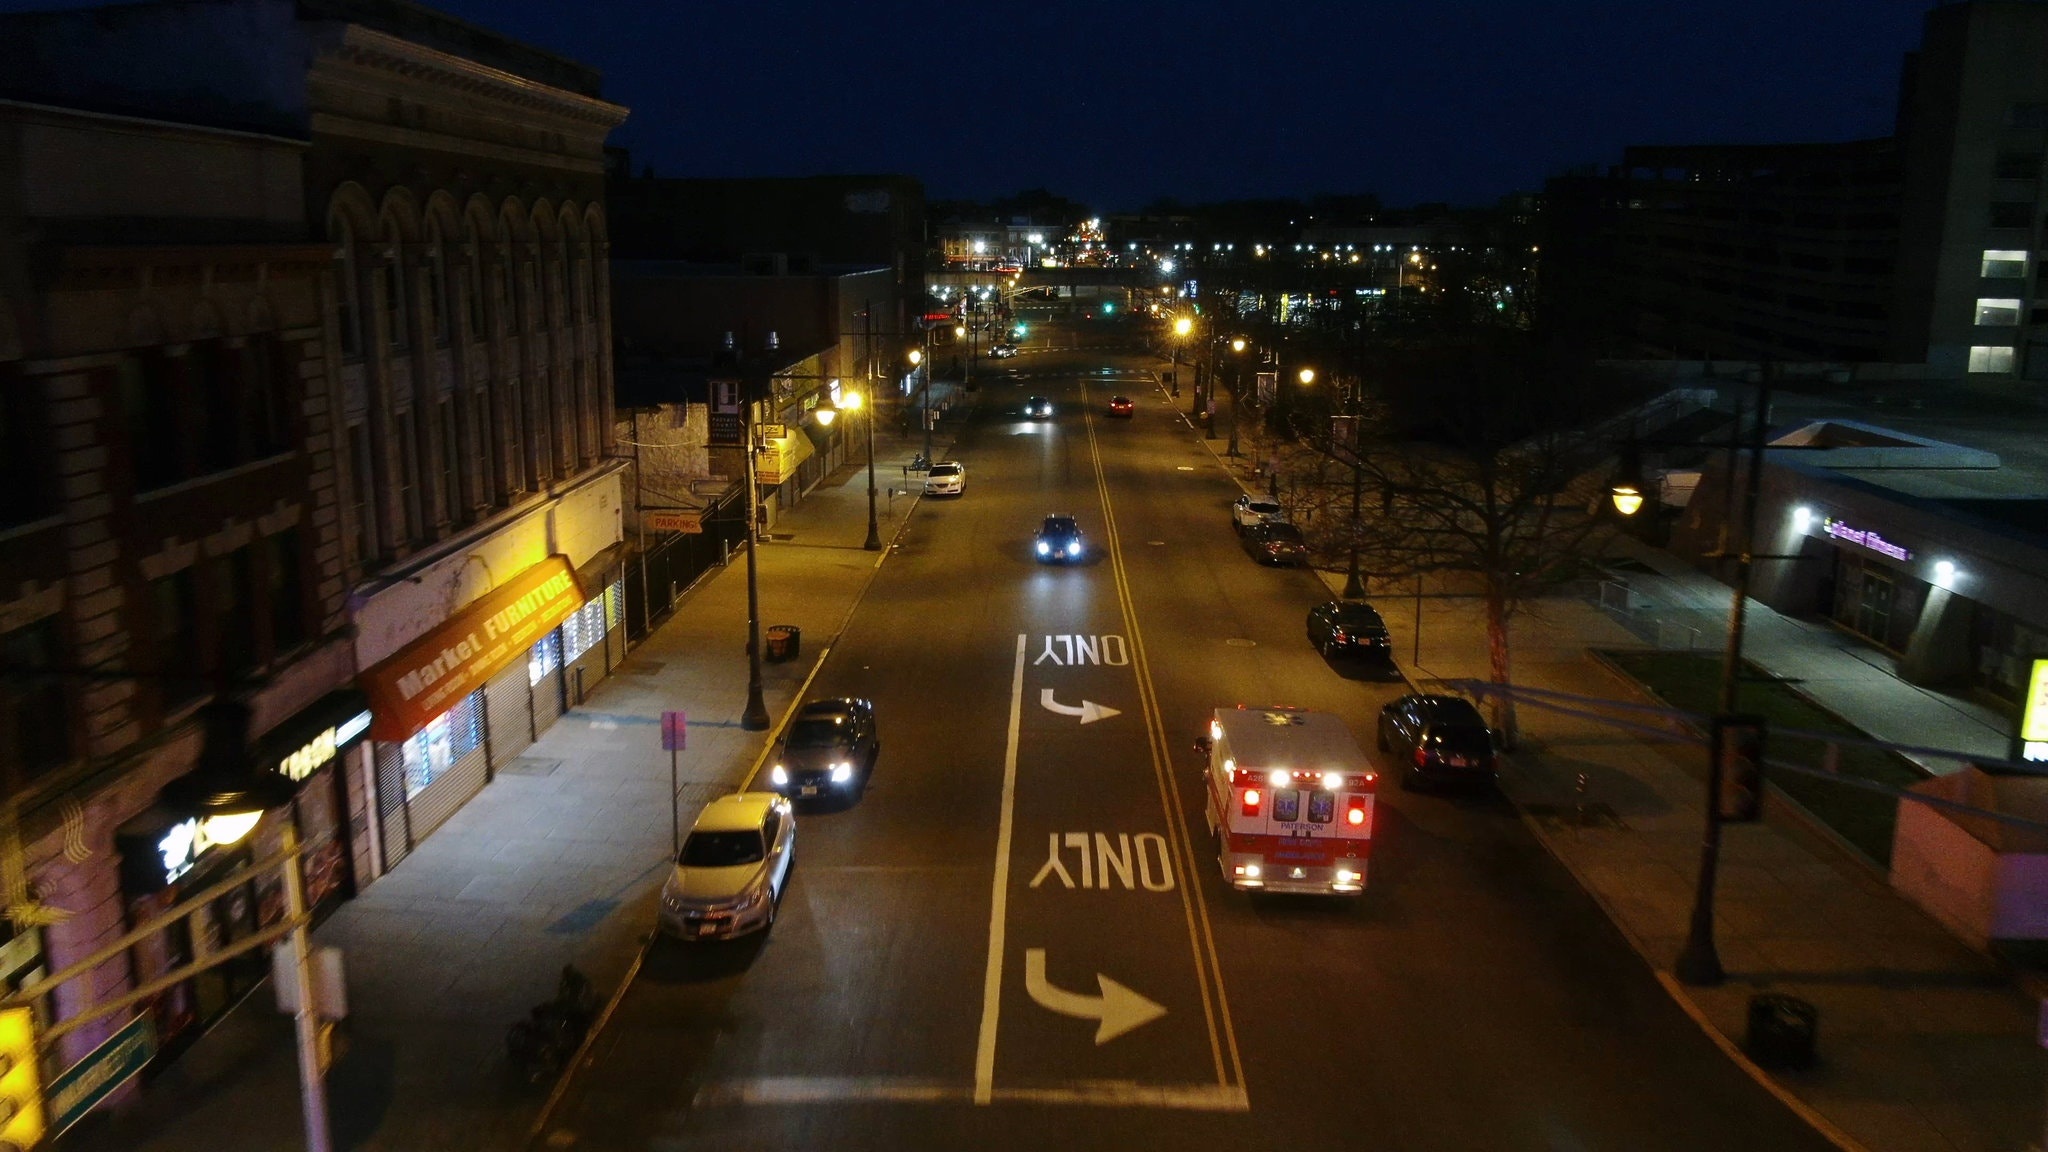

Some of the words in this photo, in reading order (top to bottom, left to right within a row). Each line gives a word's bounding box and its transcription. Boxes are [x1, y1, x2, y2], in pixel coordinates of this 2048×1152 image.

[656, 518, 697, 530] PARKING
[397, 633, 483, 700] Market
[483, 570, 573, 640] FURNITURE
[1034, 635, 1129, 666] ONLY
[1281, 822, 1325, 831] PATERSON
[1029, 832, 1175, 892] ONLY
